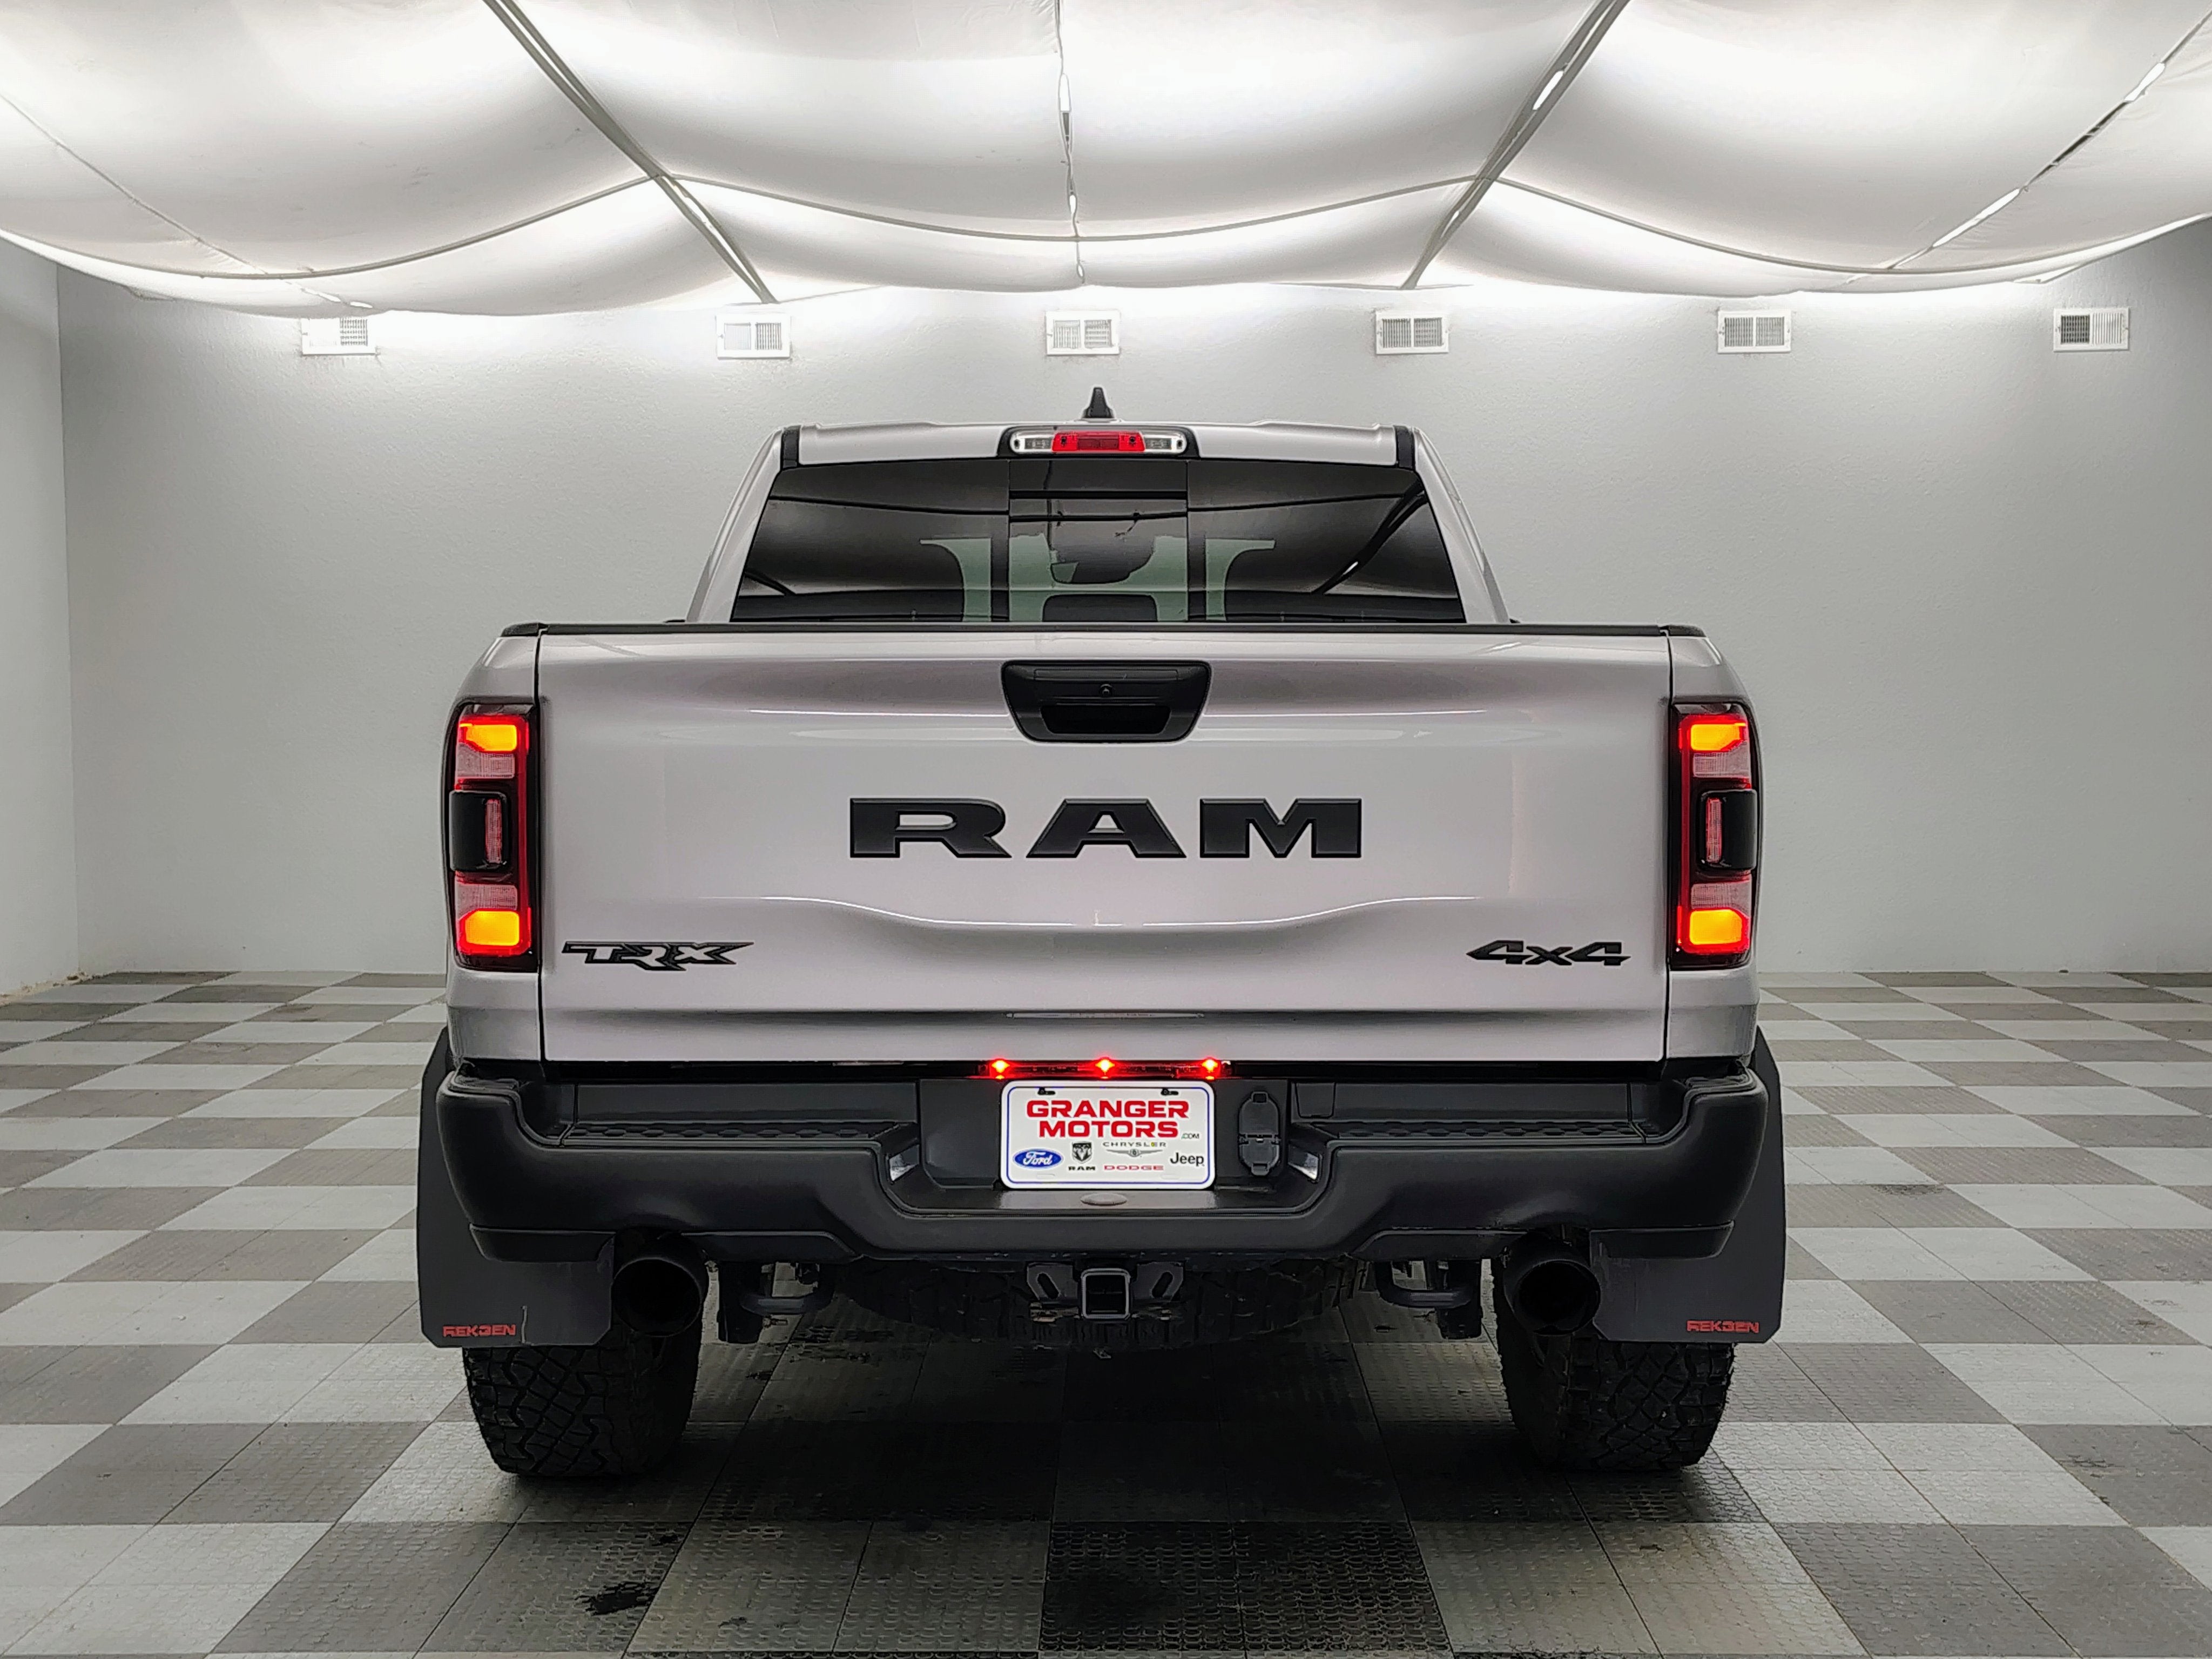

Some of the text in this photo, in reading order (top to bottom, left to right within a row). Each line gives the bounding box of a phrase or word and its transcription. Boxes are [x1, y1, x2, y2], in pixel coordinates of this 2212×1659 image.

[850, 798, 1361, 858] RAM
[562, 941, 754, 972] TRX
[1466, 940, 1631, 966] 4x4
[1027, 1100, 1189, 1118] GRANGER
[1039, 1121, 1179, 1138] MOTORS
[1023, 1151, 1053, 1165] Ford
[1170, 1152, 1204, 1166] Jeep
